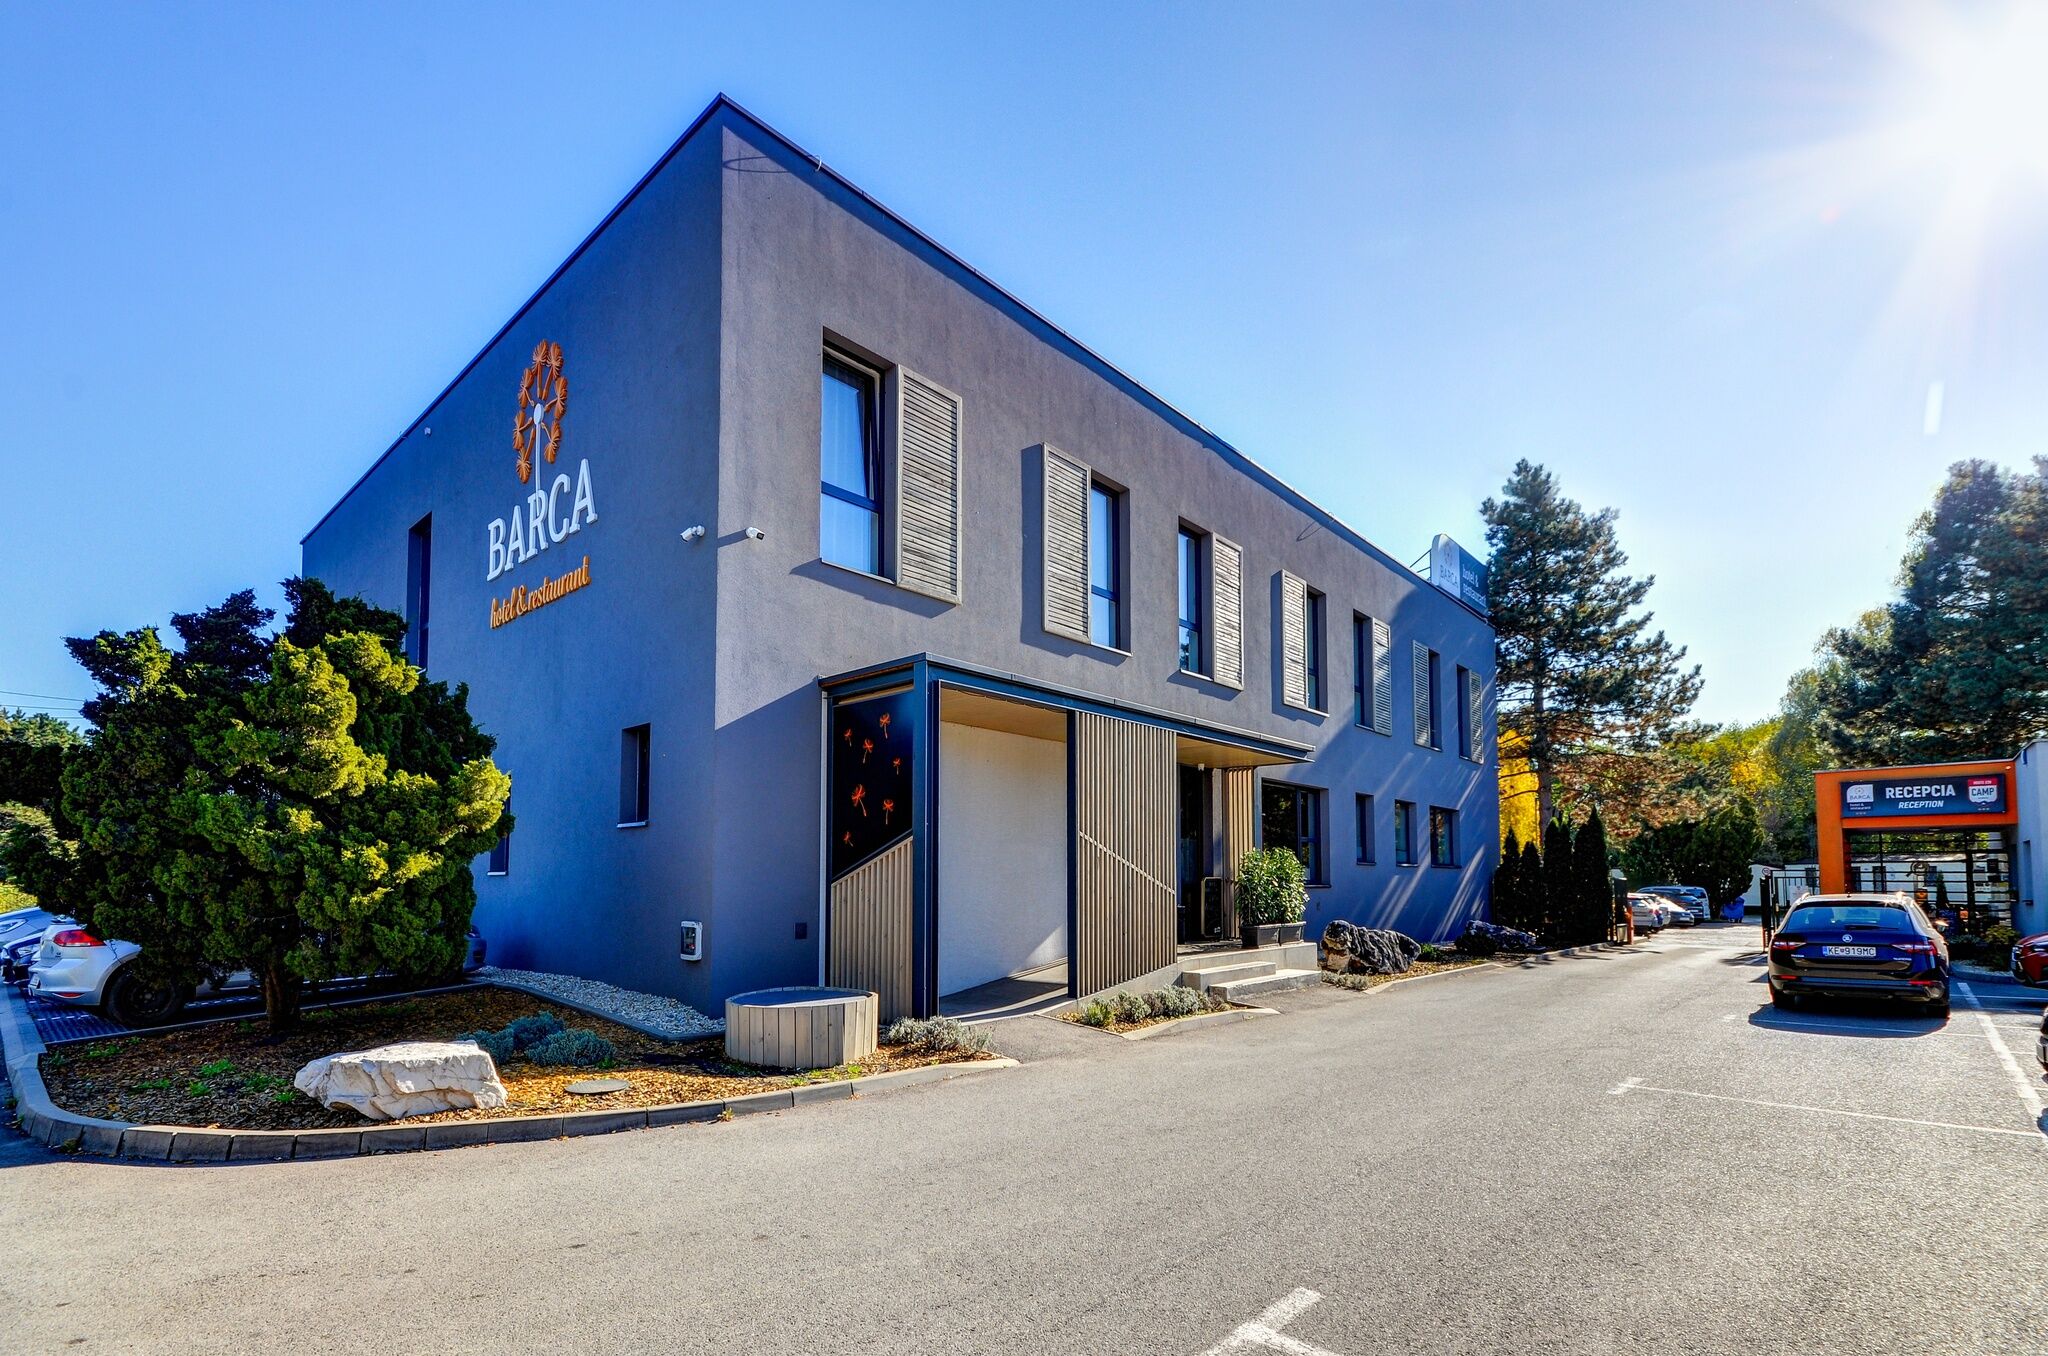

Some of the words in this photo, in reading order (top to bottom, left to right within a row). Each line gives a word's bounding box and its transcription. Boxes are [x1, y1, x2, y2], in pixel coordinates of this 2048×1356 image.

[487, 458, 598, 581] BARCA
[490, 587, 518, 629] hotel
[516, 584, 528, 616] &
[527, 554, 592, 612] restaurant
[1885, 784, 1956, 799] RECEPCIA
[1971, 788, 1995, 797] CAMP
[1898, 800, 1944, 809] RECEPTION
